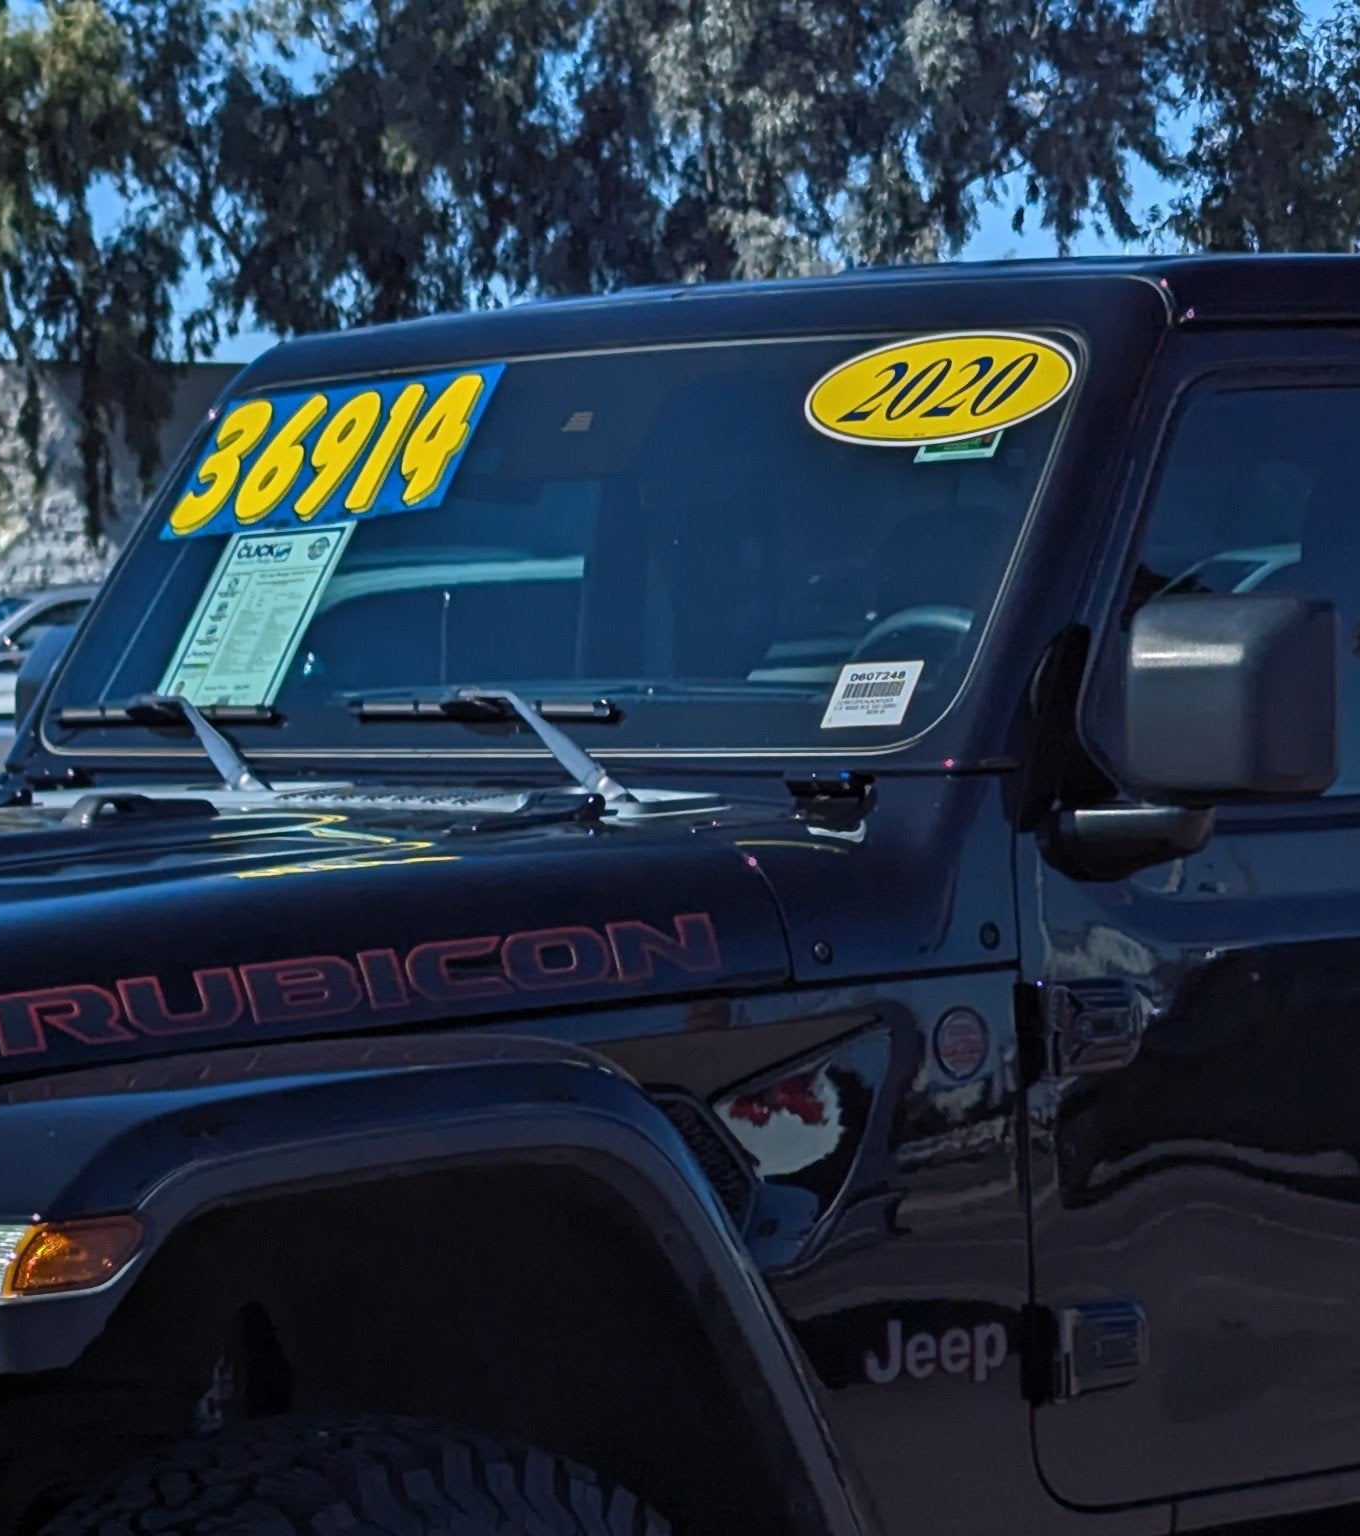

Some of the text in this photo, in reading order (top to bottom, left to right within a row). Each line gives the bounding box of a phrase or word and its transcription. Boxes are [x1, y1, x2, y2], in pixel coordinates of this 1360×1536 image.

[836, 353, 1039, 422] 2020
[170, 374, 485, 535] 36914
[865, 1319, 1008, 1383] Jeep
